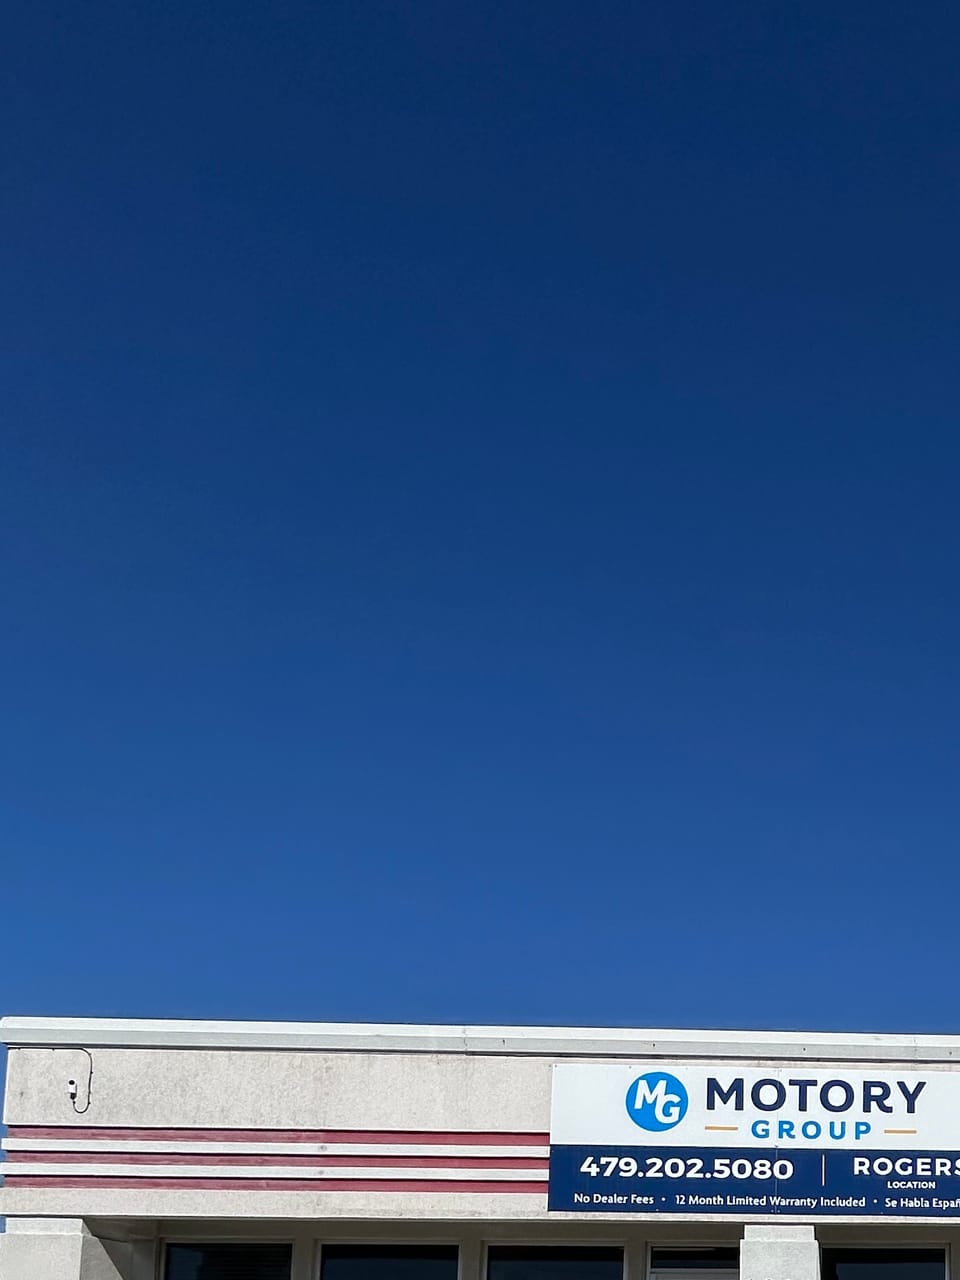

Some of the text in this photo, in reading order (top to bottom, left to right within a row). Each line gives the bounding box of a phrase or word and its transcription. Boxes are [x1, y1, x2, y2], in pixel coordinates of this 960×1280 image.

[634, 1079, 682, 1124] MG
[706, 1077, 927, 1114] MOTORY
[751, 1119, 872, 1141] GROUP
[579, 1156, 794, 1180] 479.202.5080
[887, 1181, 936, 1190] LOCATION
[574, 1193, 655, 1205] No Dealer Fees
[675, 1194, 866, 1209] 12 Month Limited Warranty Included
[884, 1197, 898, 1208] Se
[900, 1197, 930, 1208] Habla
